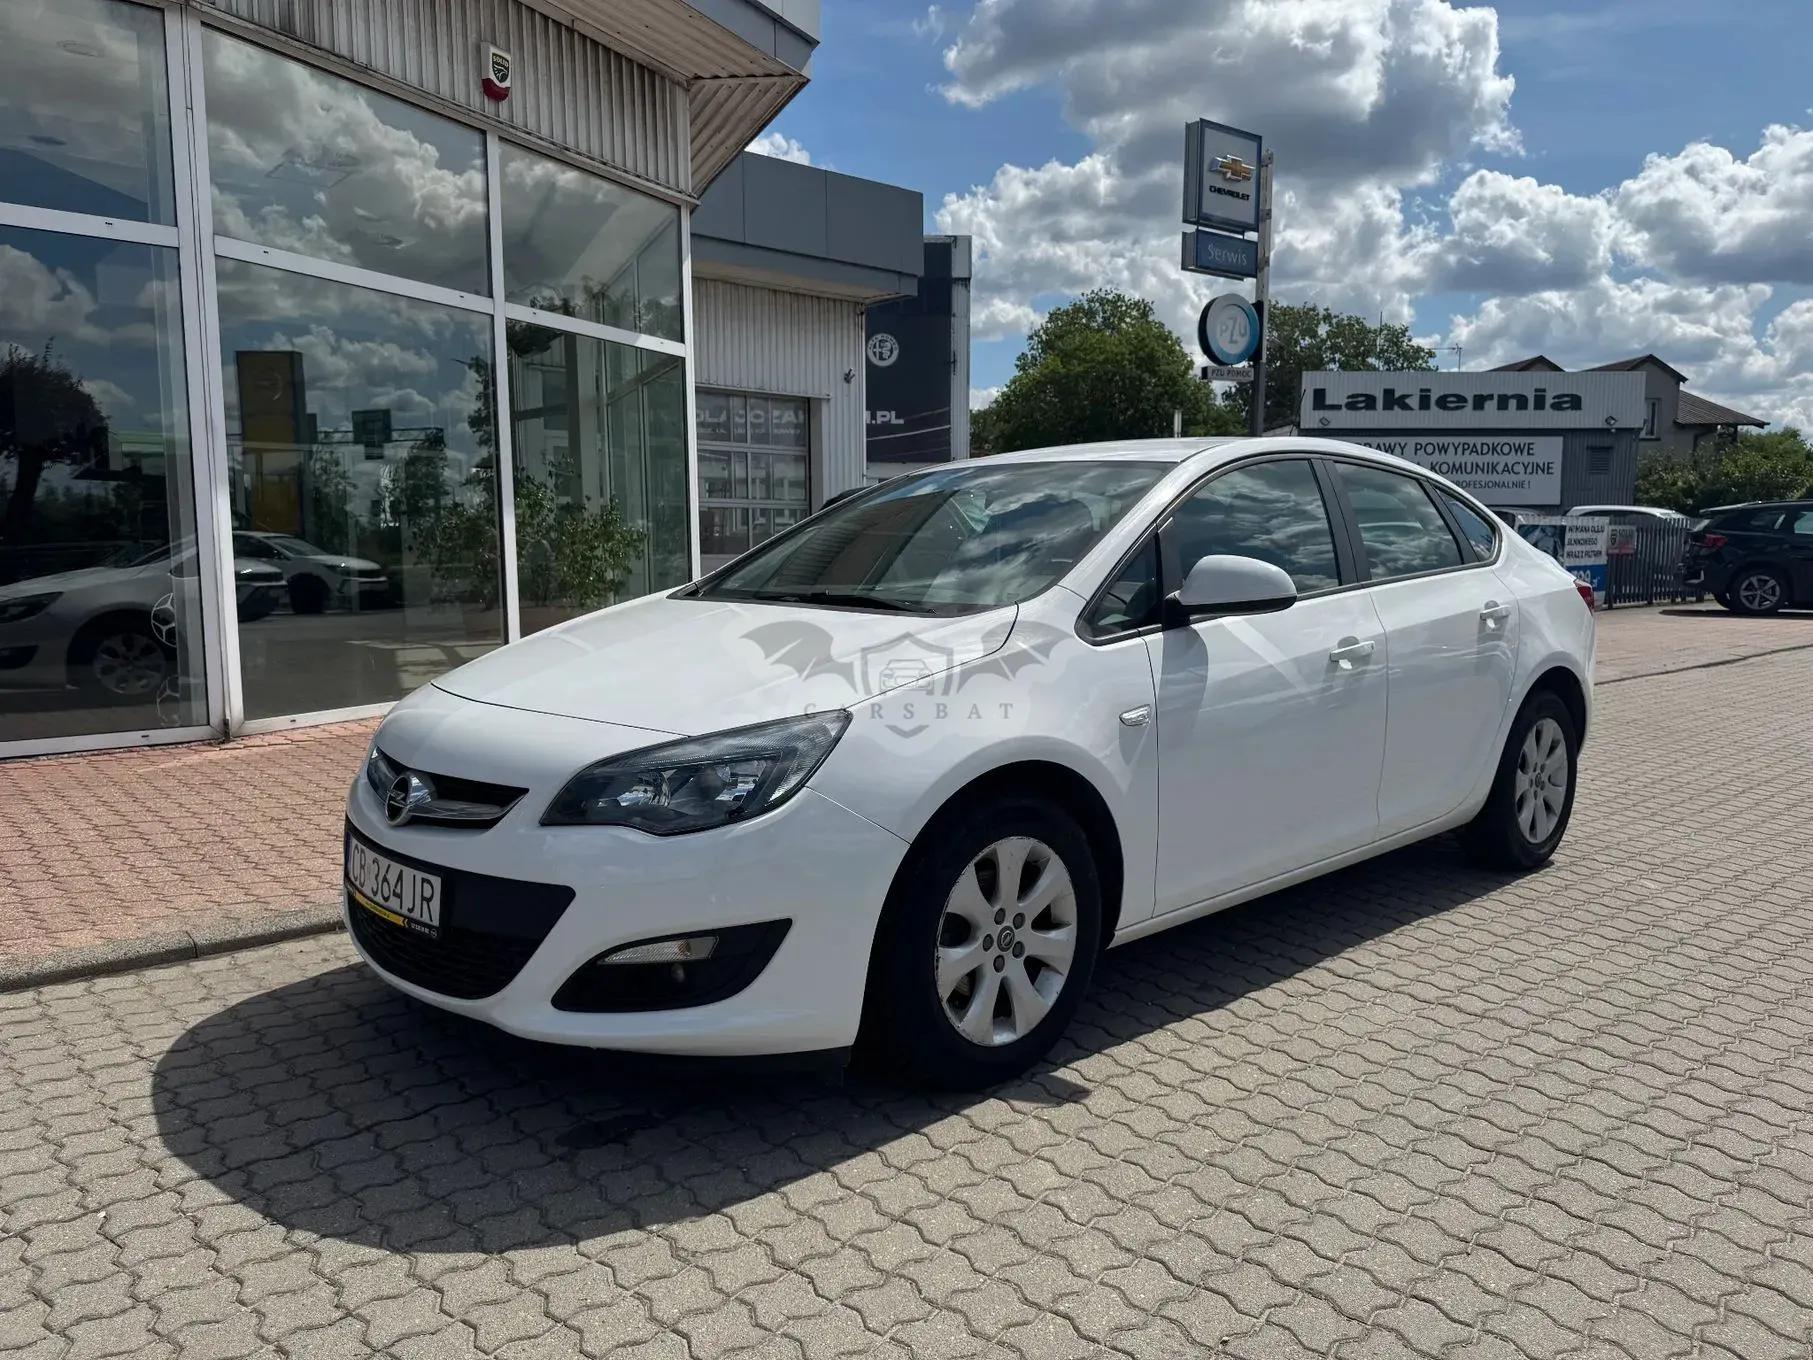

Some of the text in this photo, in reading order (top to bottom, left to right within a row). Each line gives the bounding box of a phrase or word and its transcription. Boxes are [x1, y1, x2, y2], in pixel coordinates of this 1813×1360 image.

[1209, 185, 1250, 201] CHEVROLET
[1207, 243, 1247, 266] Serwis
[1219, 317, 1247, 344] PZU
[1211, 368, 1225, 377] PZU
[1312, 388, 1583, 411] Lakiernia
[1414, 442, 1536, 457] POWYPADKOWE
[1430, 462, 1555, 476] KOMUNIKACYJNE
[352, 843, 435, 922] CB 364JR
